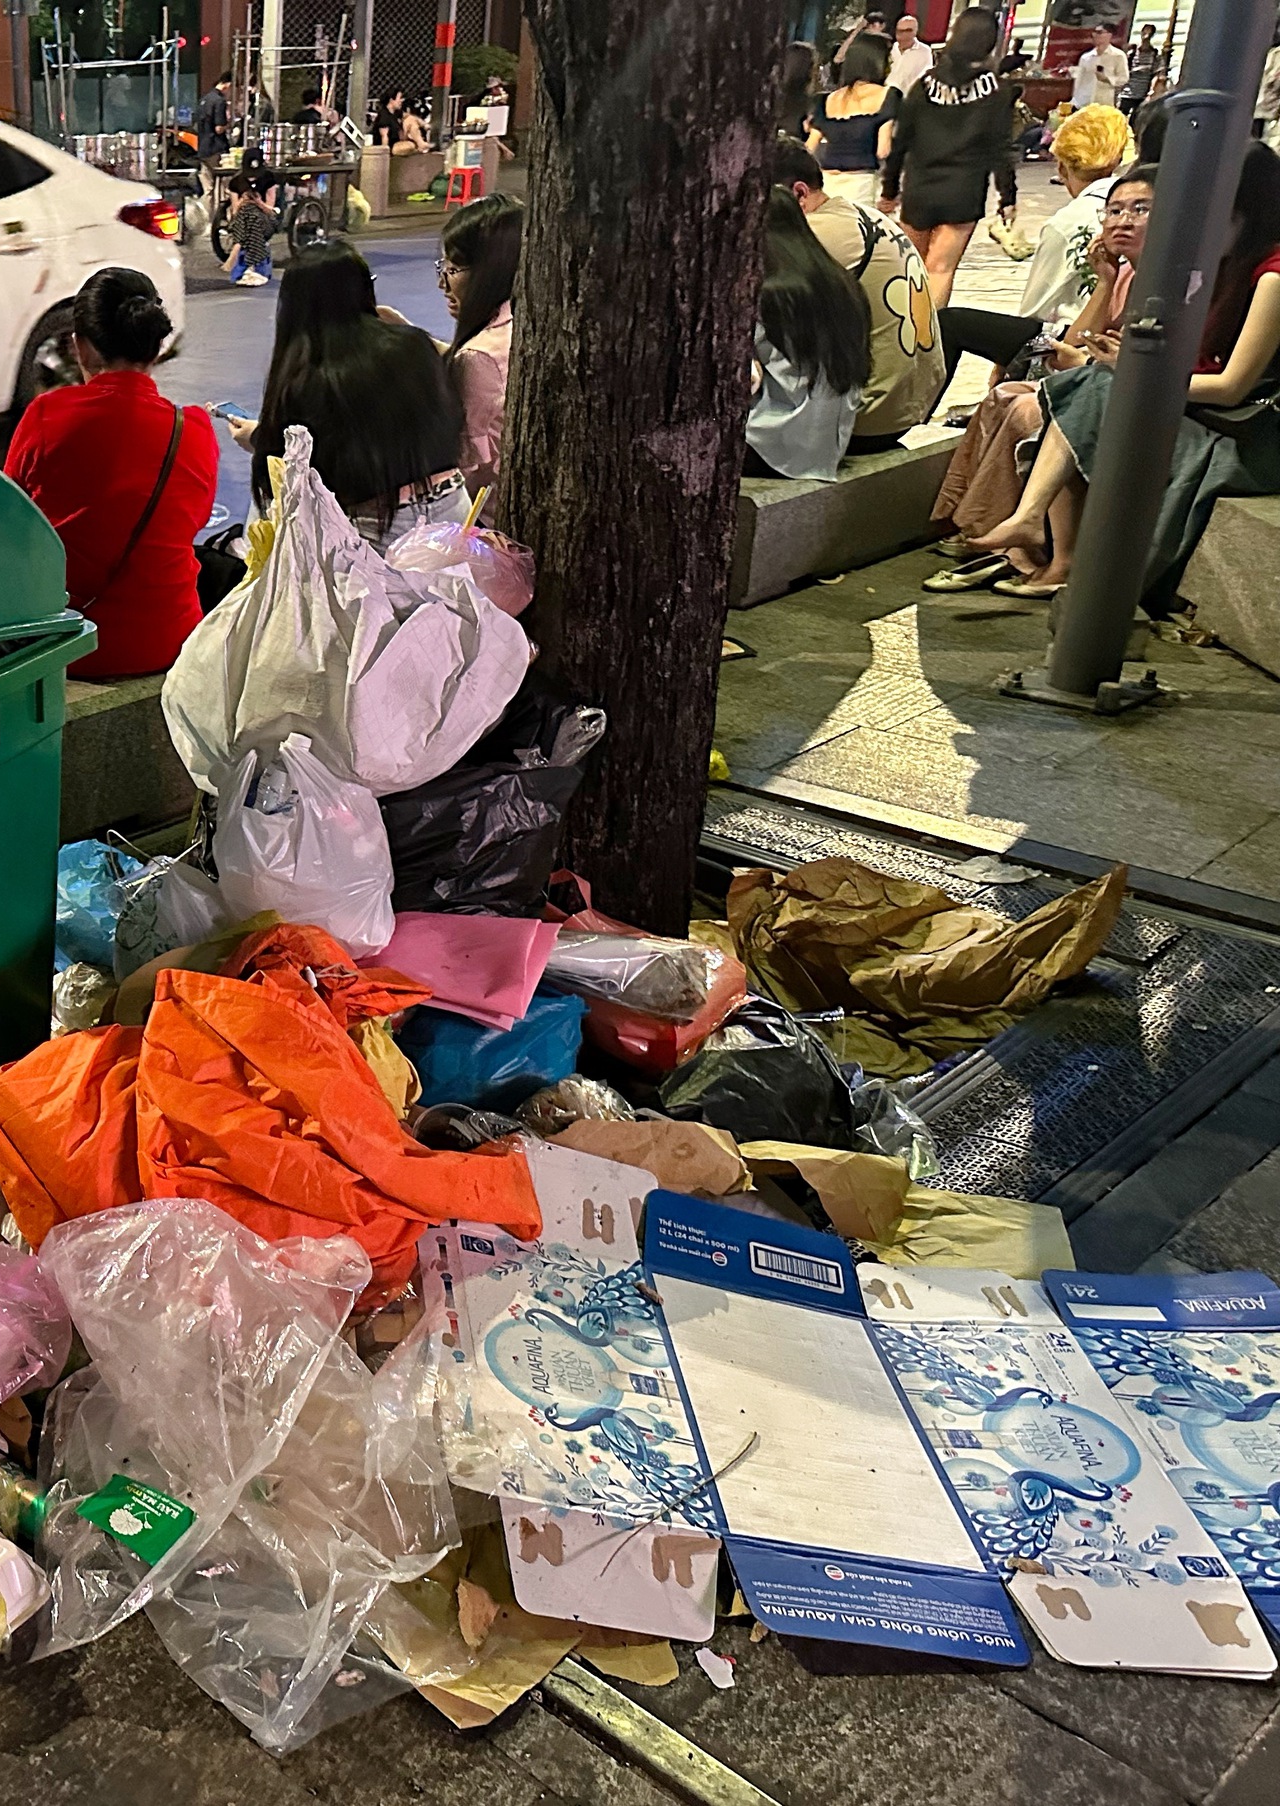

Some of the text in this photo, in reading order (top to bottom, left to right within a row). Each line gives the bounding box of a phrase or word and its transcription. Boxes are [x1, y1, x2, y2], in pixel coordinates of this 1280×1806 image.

[674, 1230, 687, 1240] (24
[711, 1240, 726, 1249] 500
[1072, 1287, 1098, 1299] 24
[1179, 1294, 1267, 1314] AQUAFINA
[1048, 1332, 1072, 1348] 24
[523, 1336, 554, 1396] AQUAFINA
[1050, 1414, 1104, 1471] AQUAFINA
[501, 1471, 520, 1494] 24
[158, 1503, 180, 1519] RAU
[760, 1604, 1016, 1648] NƯỚC UỐNG ĐÓNG CHAI AQUAFINA
